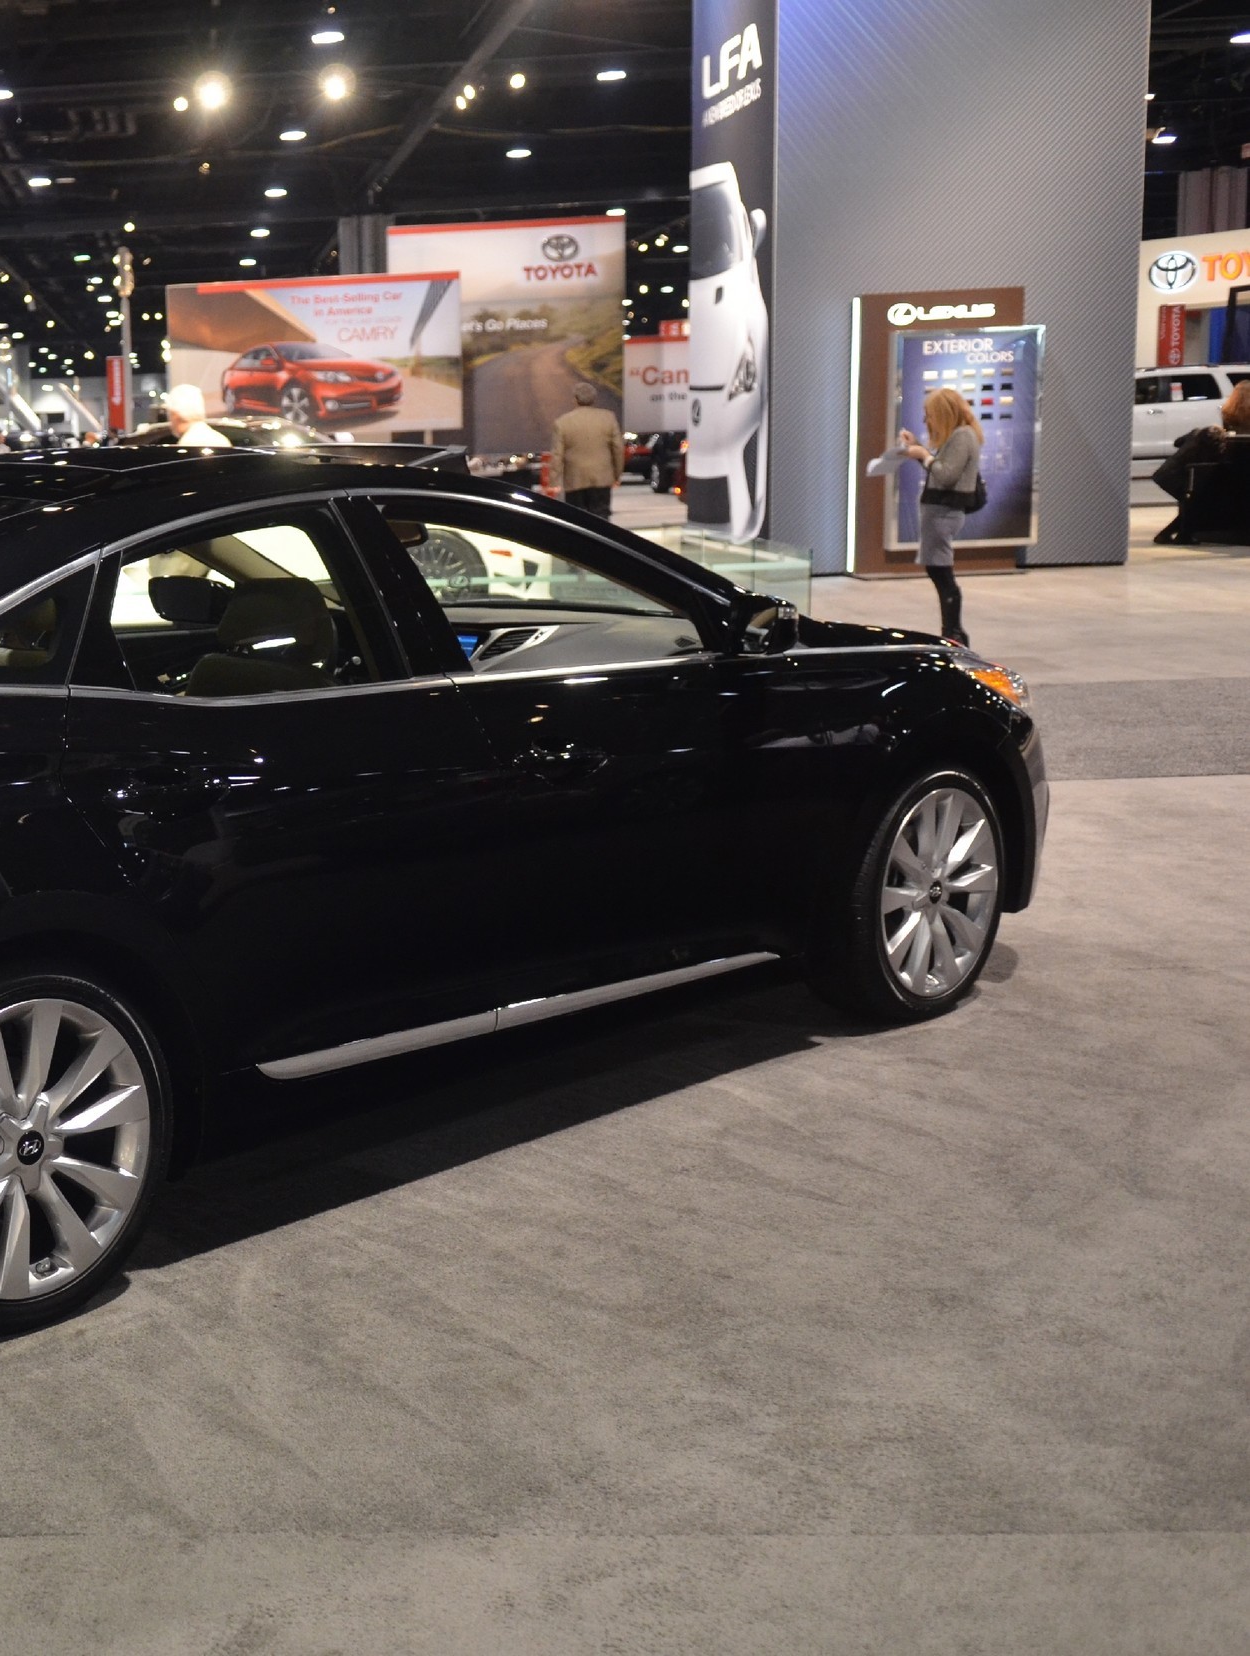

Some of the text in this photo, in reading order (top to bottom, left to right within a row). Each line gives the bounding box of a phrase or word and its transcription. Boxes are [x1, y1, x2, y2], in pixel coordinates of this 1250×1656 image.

[701, 23, 762, 99] LFA
[523, 262, 597, 281] TOYOTA
[916, 303, 996, 321] LEXUS
[337, 325, 398, 343] CAMRY
[461, 320, 483, 332] et's
[1171, 305, 1181, 347] TOYOTA
[922, 338, 994, 355] EXTERIOR
[966, 350, 1014, 363] COLORS
